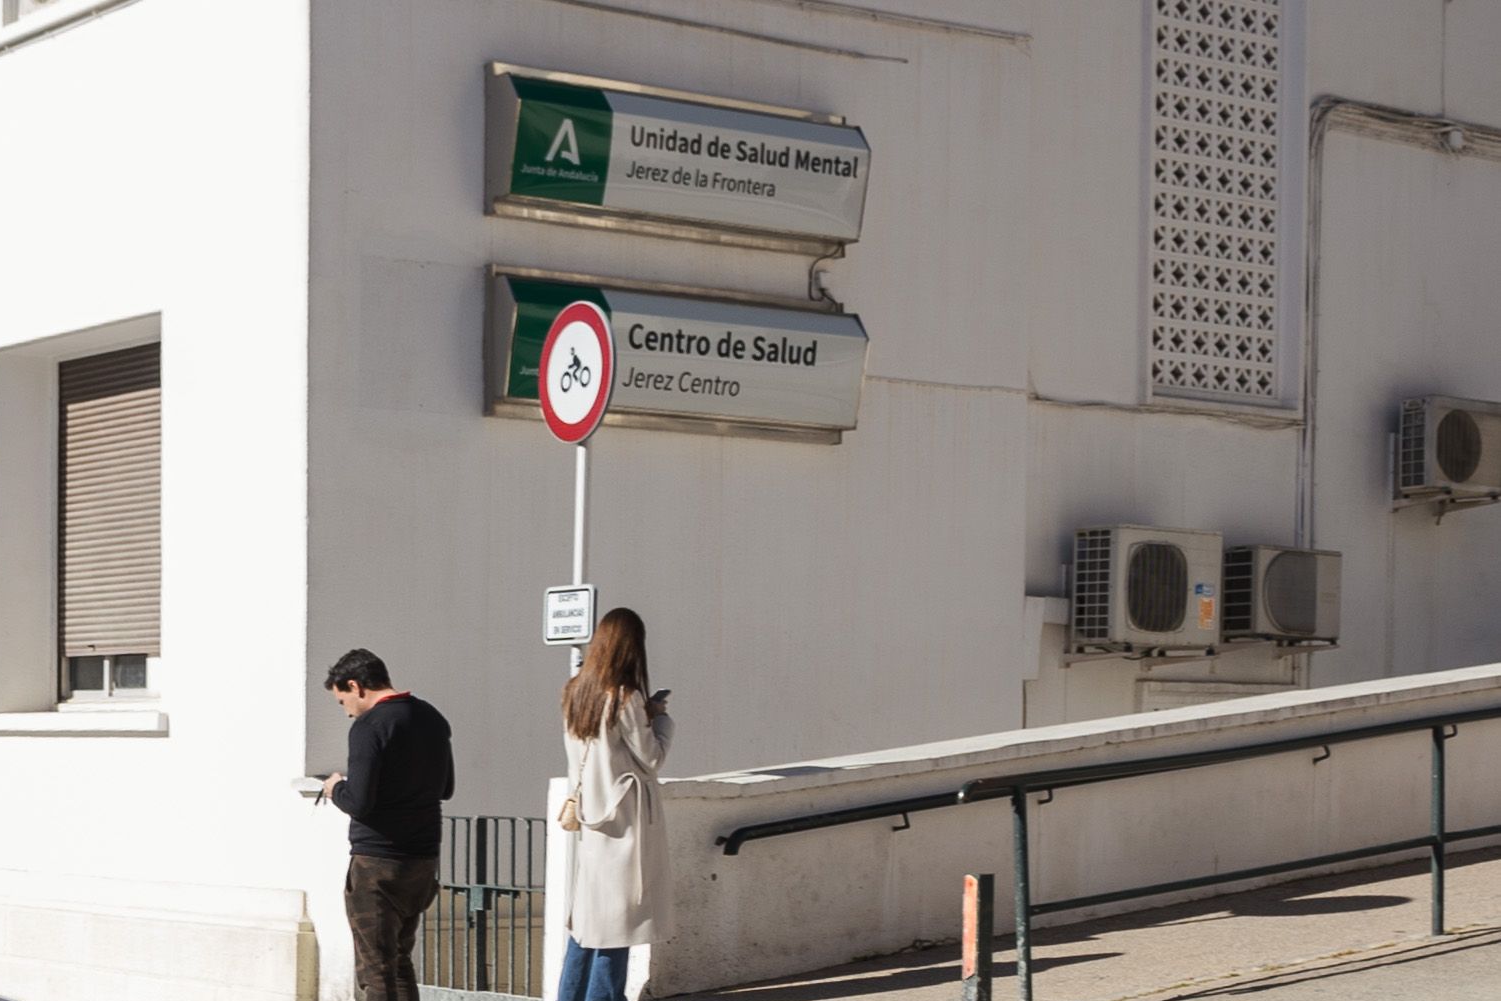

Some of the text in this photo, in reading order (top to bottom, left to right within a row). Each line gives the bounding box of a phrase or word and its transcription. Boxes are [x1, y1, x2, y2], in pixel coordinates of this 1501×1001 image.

[630, 125, 859, 179] Unidad de Salud Mental
[626, 161, 776, 198] Jerez de la Frontera
[628, 323, 818, 366] Centro de Salud
[622, 367, 740, 397] Jerez Centro
